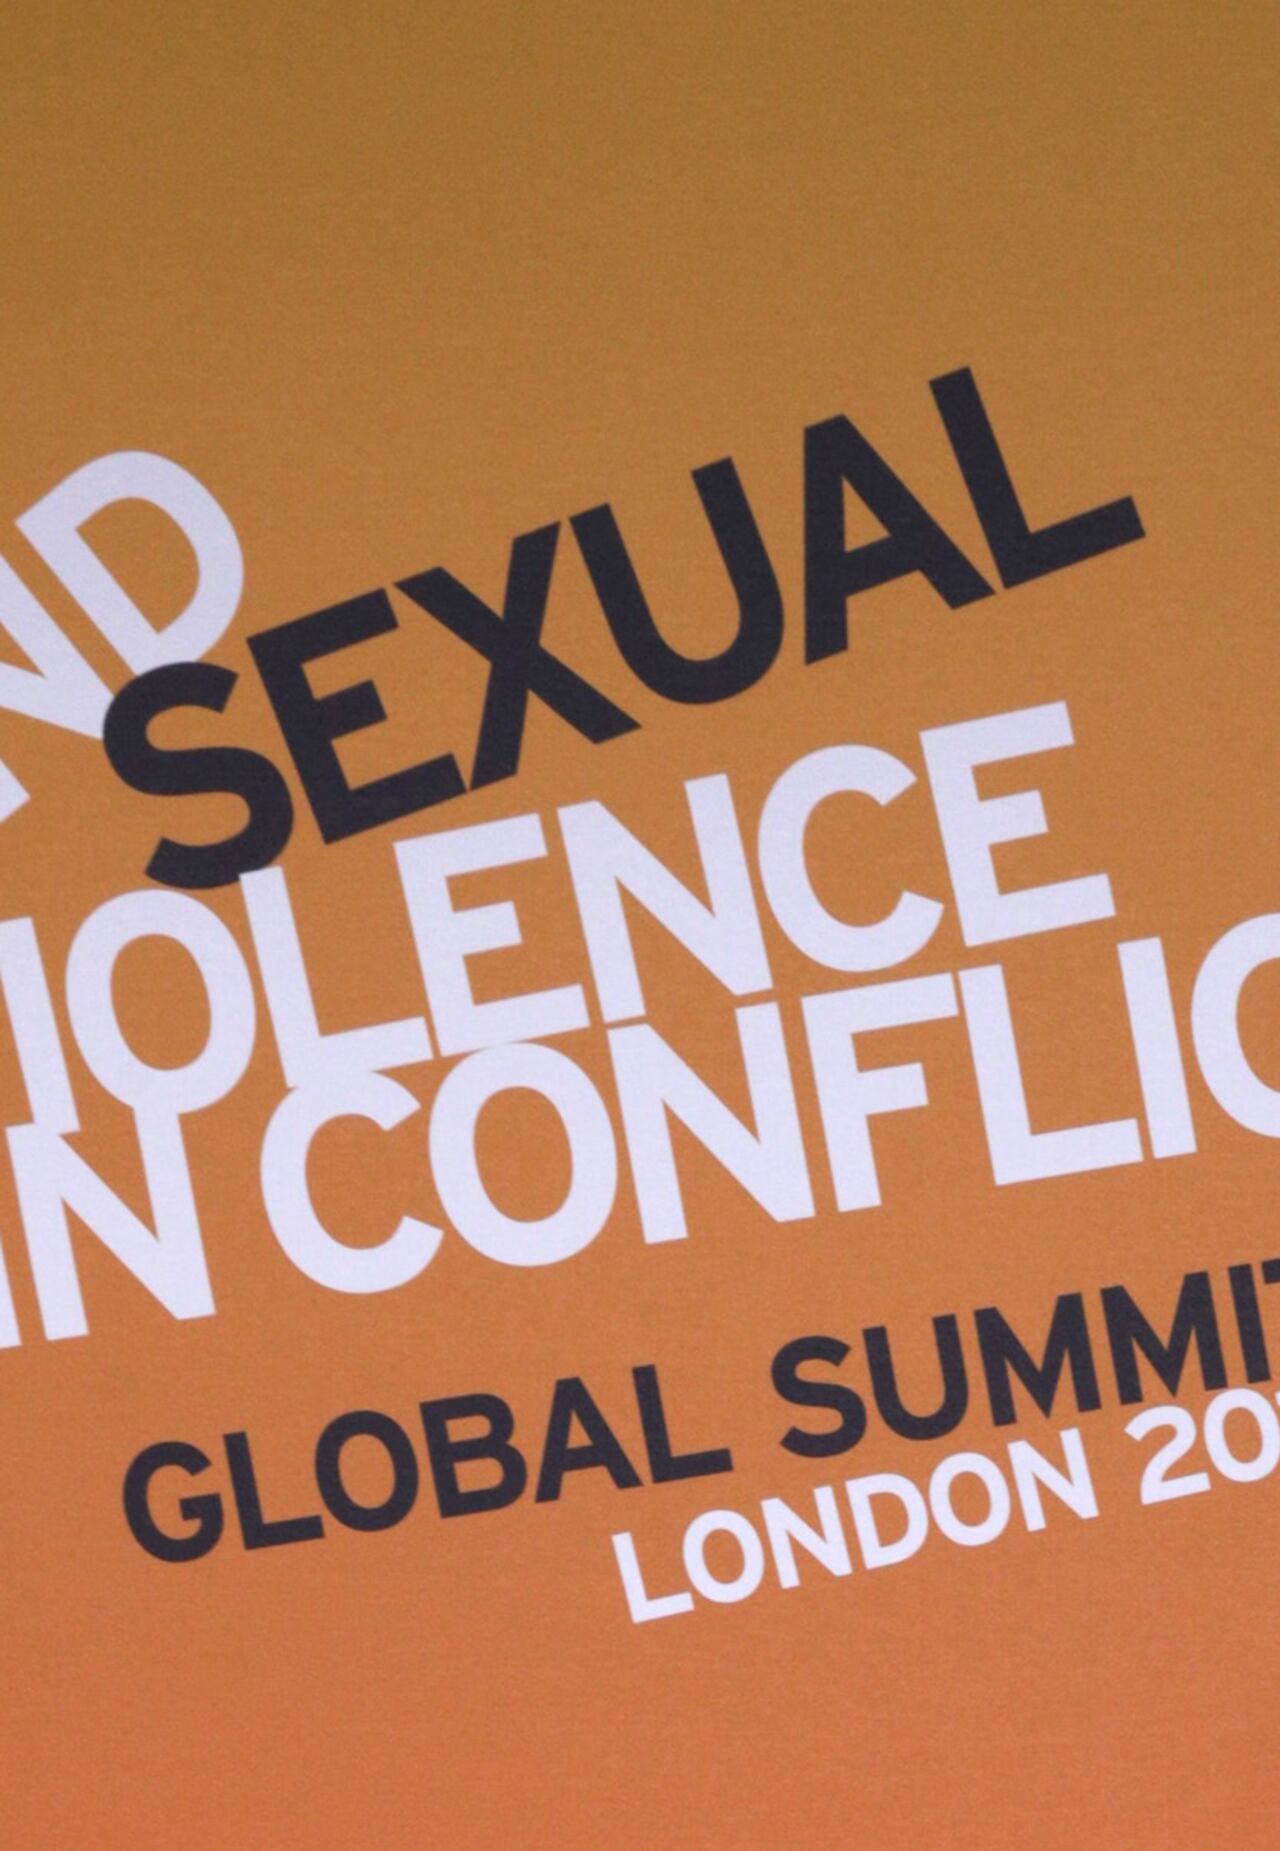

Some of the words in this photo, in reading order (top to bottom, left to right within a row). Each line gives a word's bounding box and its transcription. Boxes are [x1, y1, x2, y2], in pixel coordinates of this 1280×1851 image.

[102, 365, 1147, 890] SEXUAL
[0, 700, 1116, 1136] IOLENCE
[0, 1100, 216, 1349] N
[121, 1364, 733, 1563] GLOBAL
[612, 1427, 1100, 1623] LONDON
